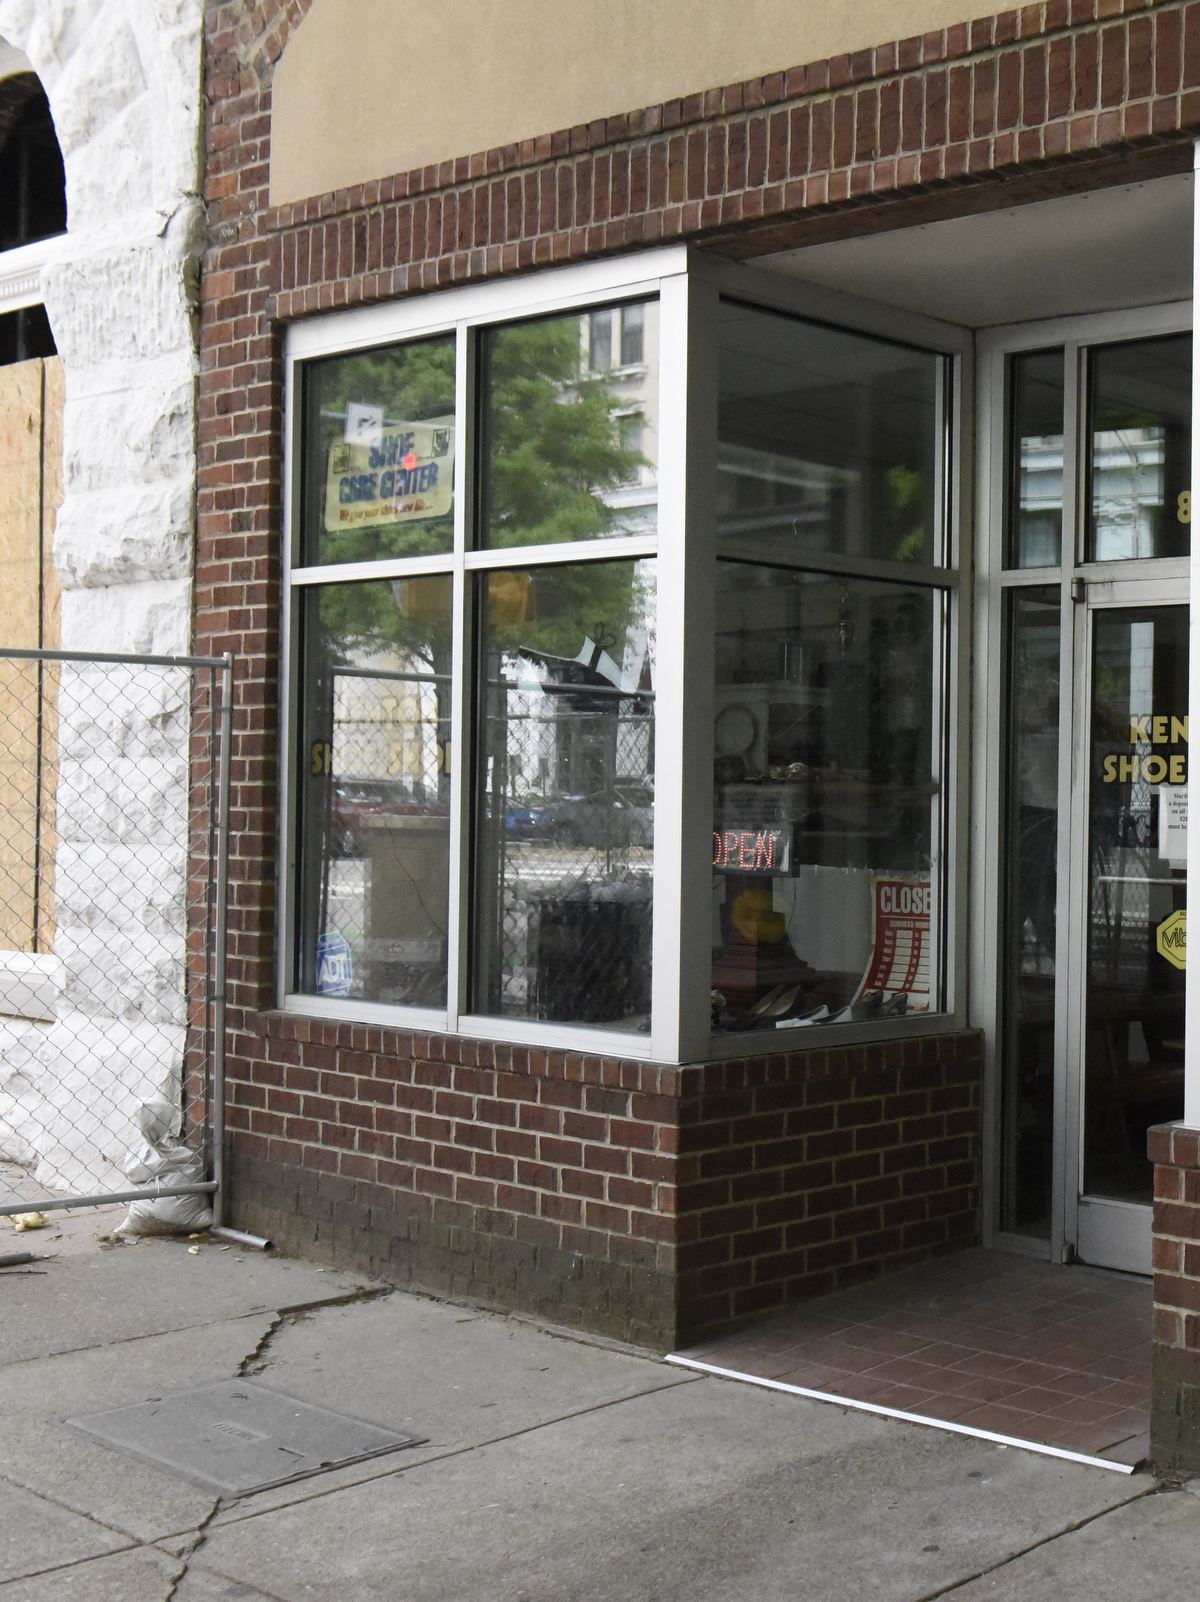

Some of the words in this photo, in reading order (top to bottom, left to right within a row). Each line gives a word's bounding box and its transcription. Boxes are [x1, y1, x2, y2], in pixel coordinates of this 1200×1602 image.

[339, 473, 378, 504] CARE
[1130, 715, 1189, 744] KEN
[1103, 755, 1187, 783] SHOE
[880, 886, 931, 914] CLOSE
[318, 952, 347, 985] ADT
